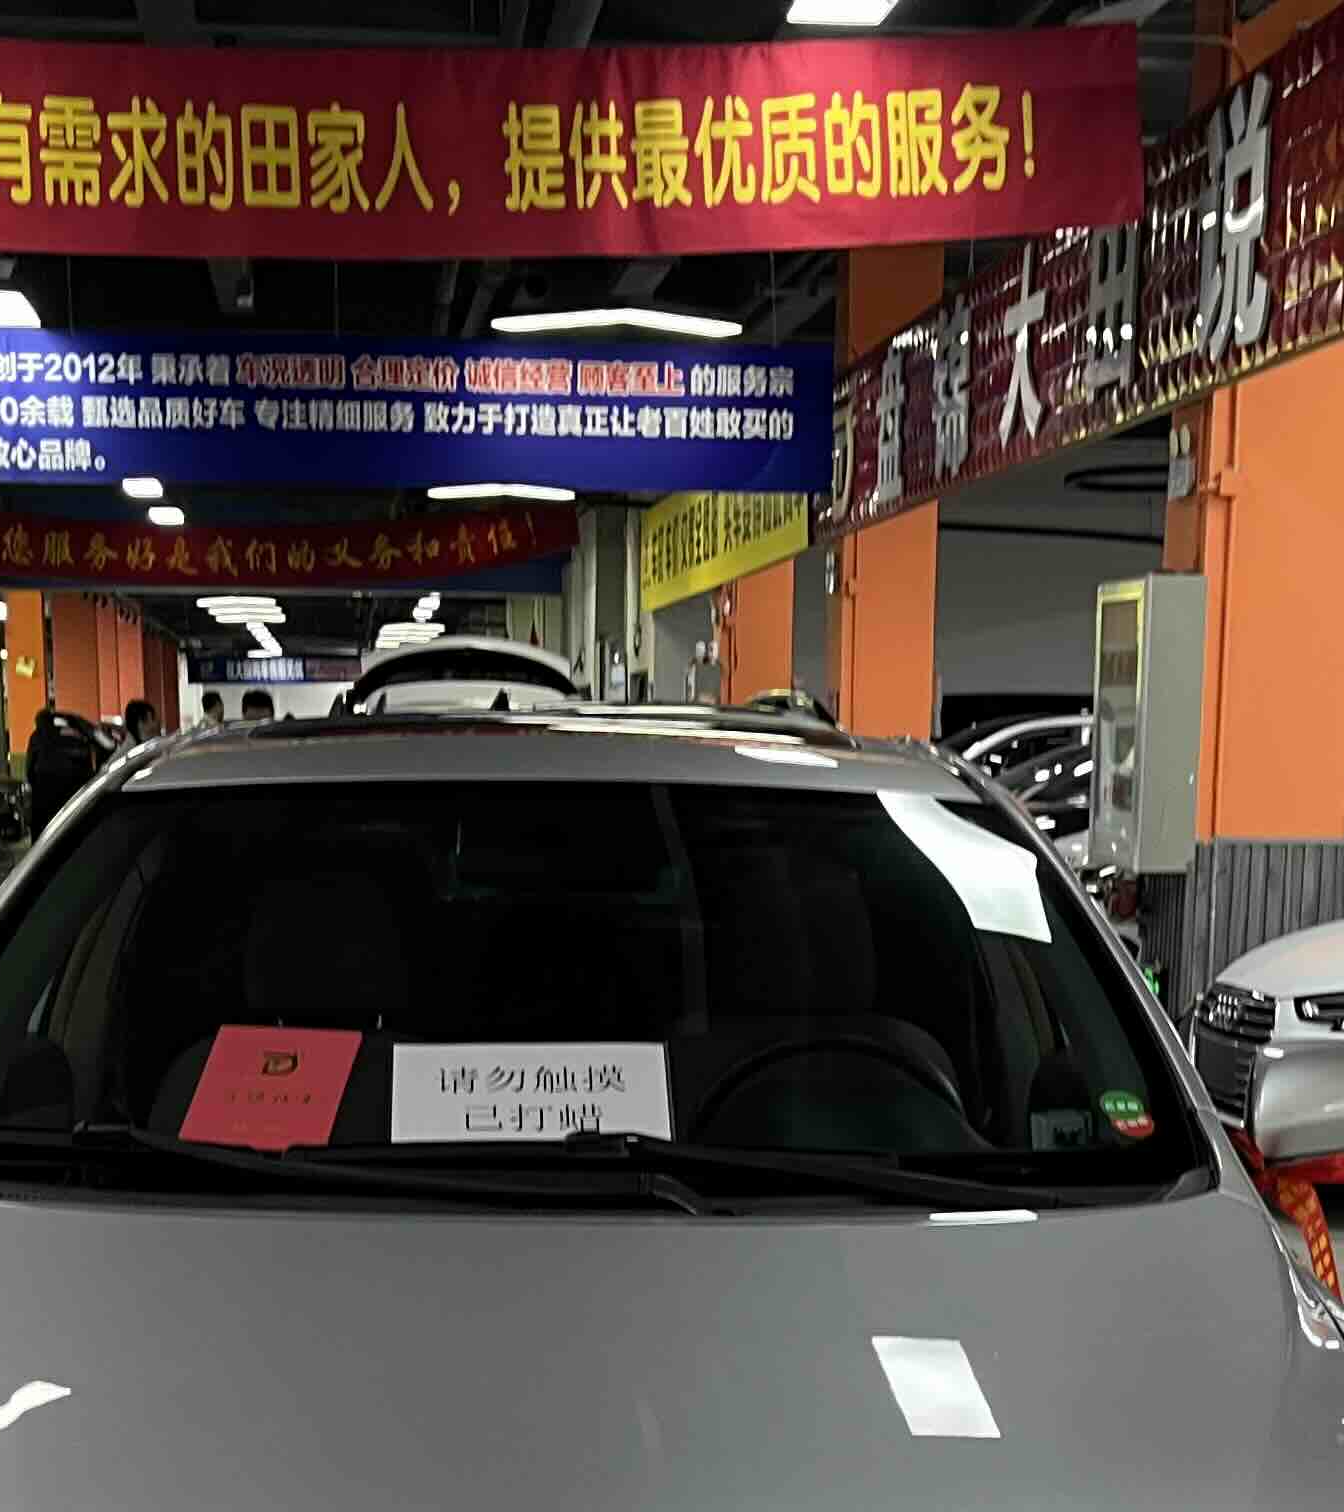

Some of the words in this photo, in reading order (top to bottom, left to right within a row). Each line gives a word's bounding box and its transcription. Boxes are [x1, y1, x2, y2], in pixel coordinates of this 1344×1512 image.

[435, 1064, 626, 1095] 请勿触摸
[464, 1103, 603, 1133] 已打蜡
